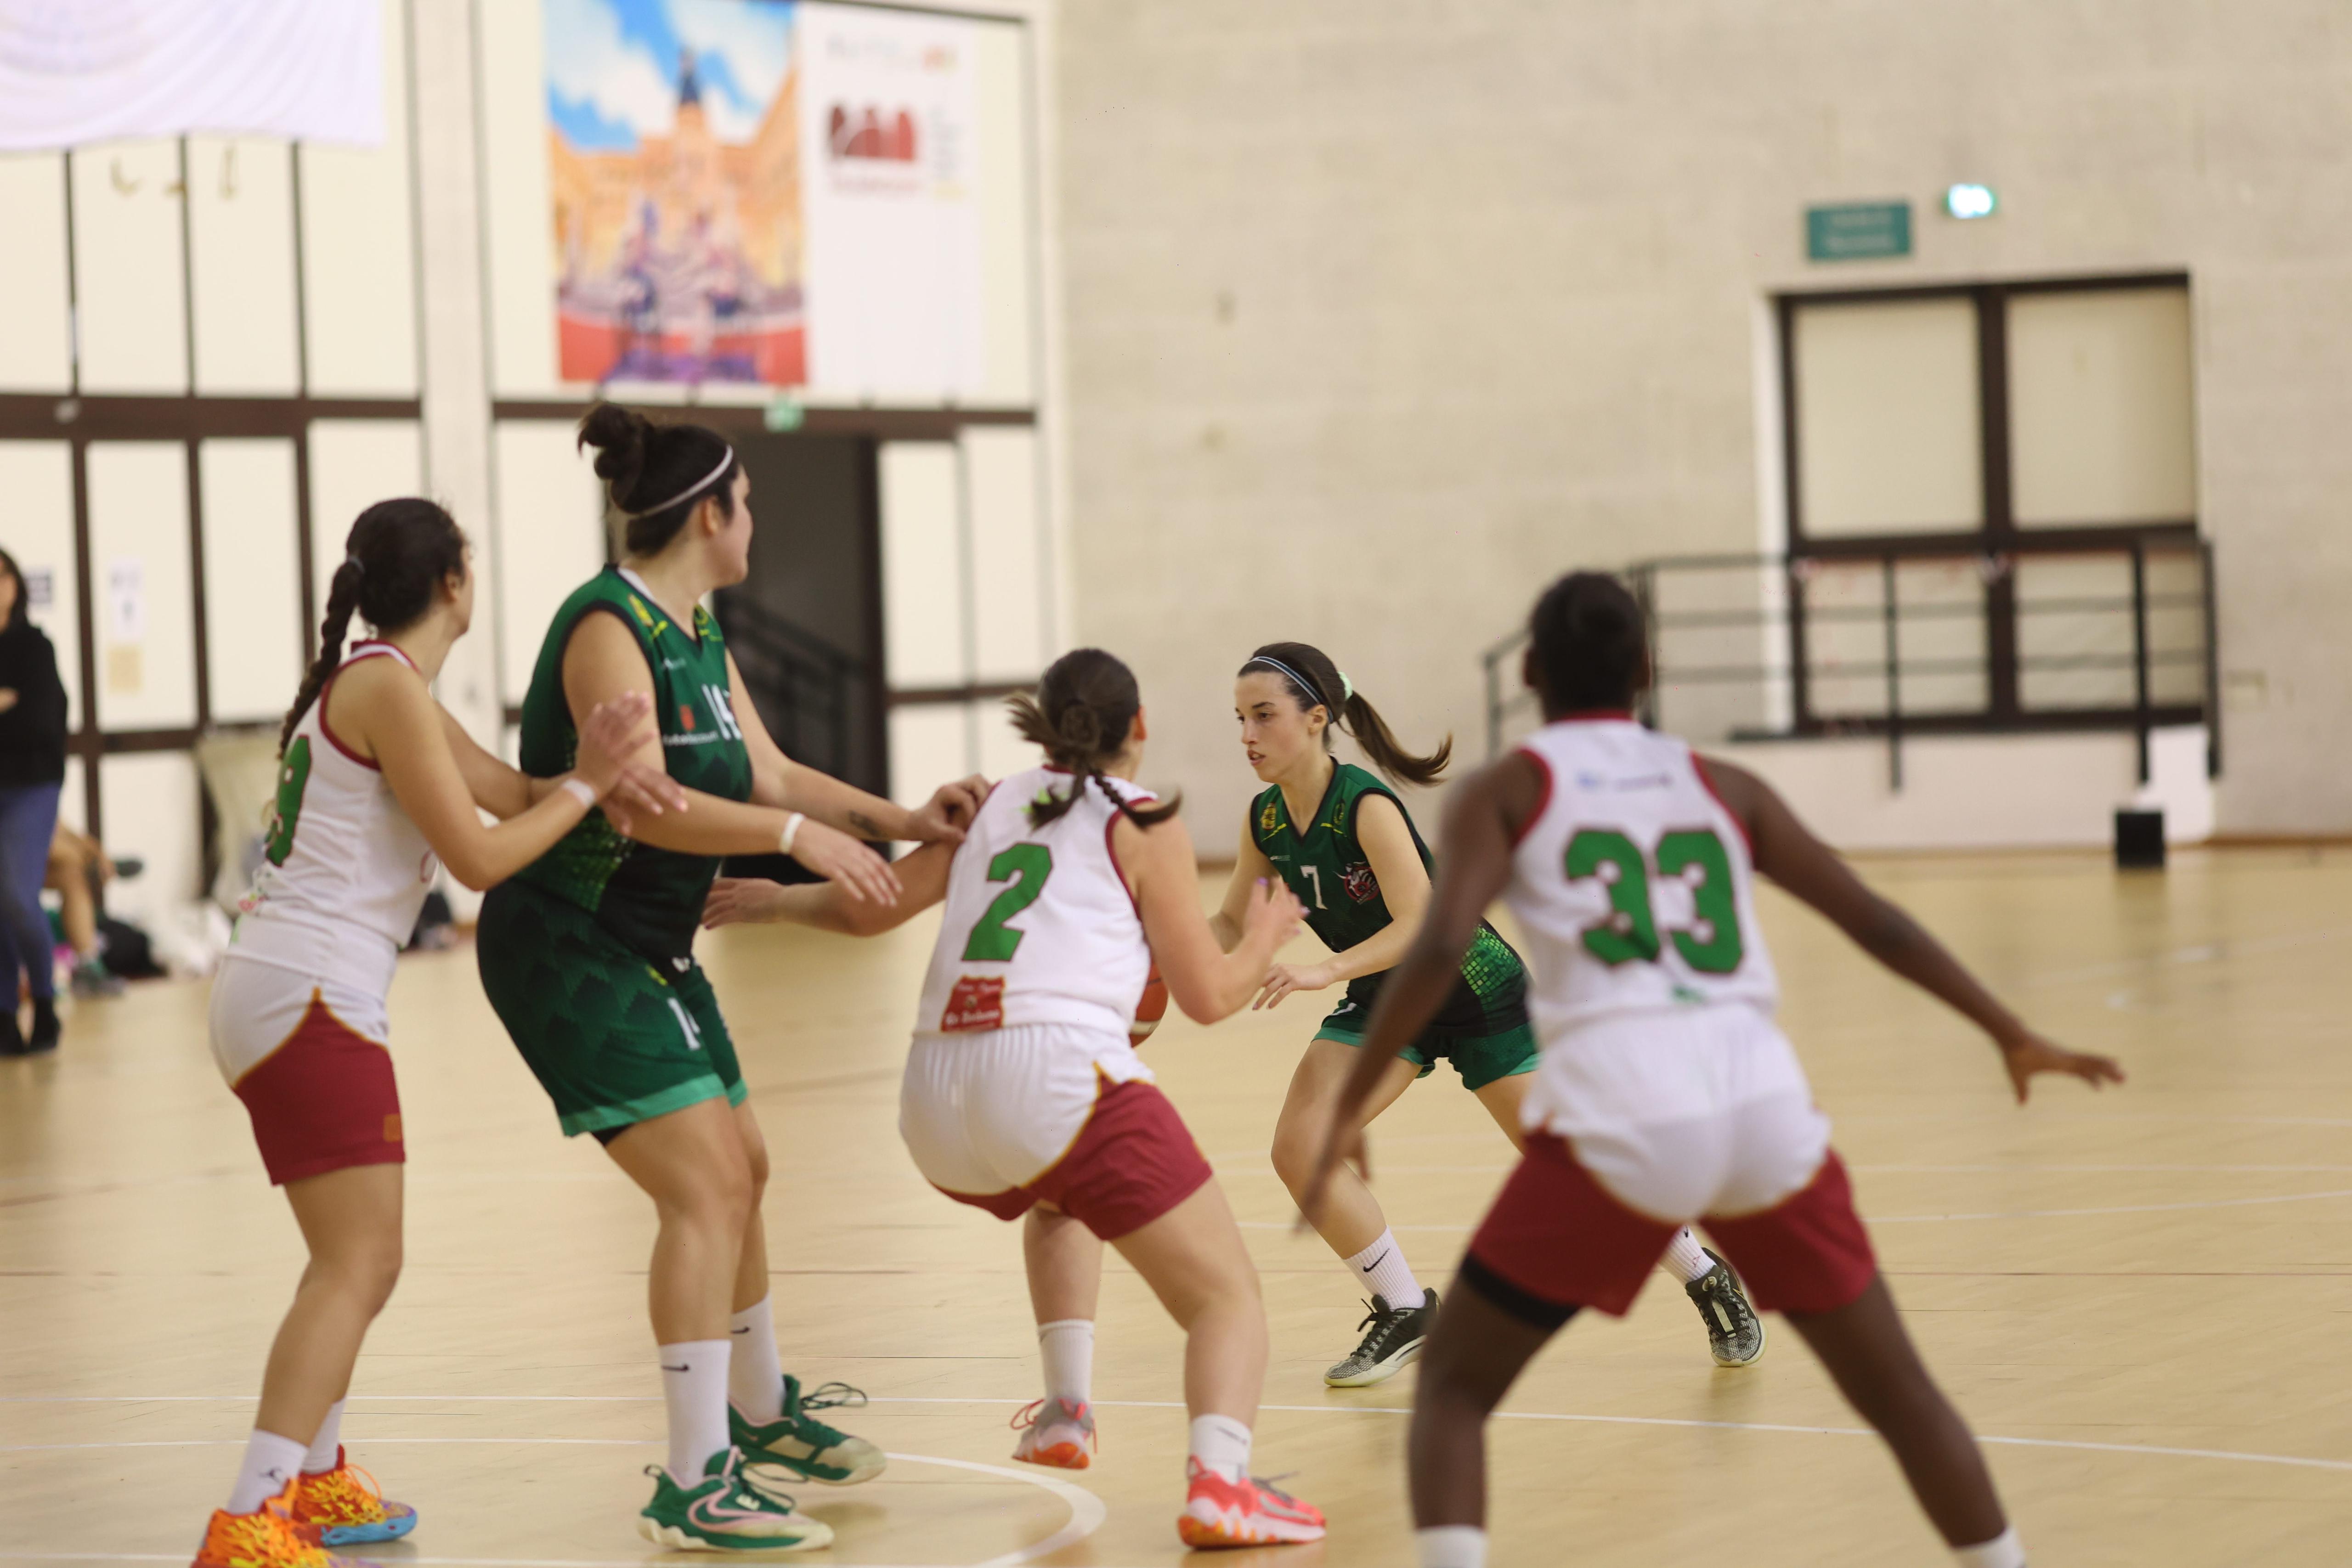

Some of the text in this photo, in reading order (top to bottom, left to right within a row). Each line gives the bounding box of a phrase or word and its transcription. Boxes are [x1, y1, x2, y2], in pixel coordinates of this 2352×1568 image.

[961, 841, 1053, 962] 2
[1300, 865, 1328, 910] 7
[1564, 828, 1744, 976] 33
